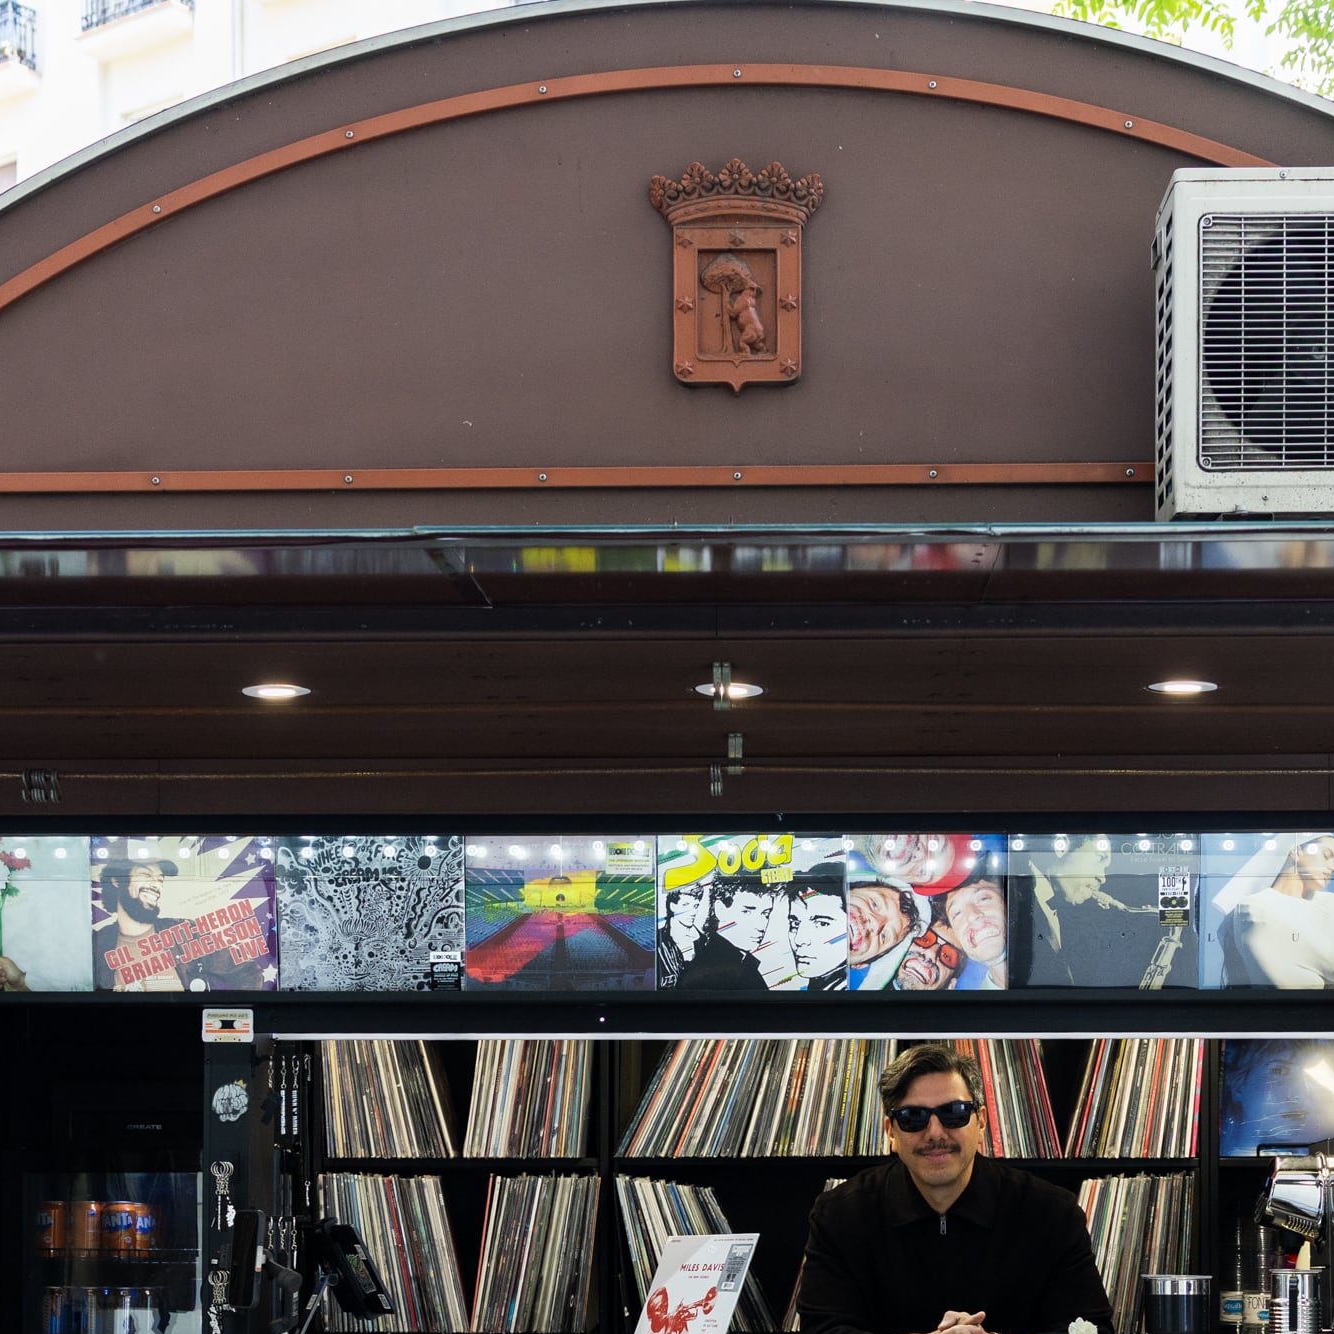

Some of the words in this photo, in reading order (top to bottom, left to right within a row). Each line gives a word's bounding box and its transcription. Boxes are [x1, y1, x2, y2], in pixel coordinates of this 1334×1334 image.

[105, 946, 133, 972] GIL
[138, 898, 255, 961] SCOTT-HERON
[120, 951, 176, 986] BRIAN
[179, 916, 263, 965] JACKSON
[230, 934, 271, 966] LIVE
[679, 1263, 700, 1272] MILES
[701, 1263, 725, 1272] DAVIS
